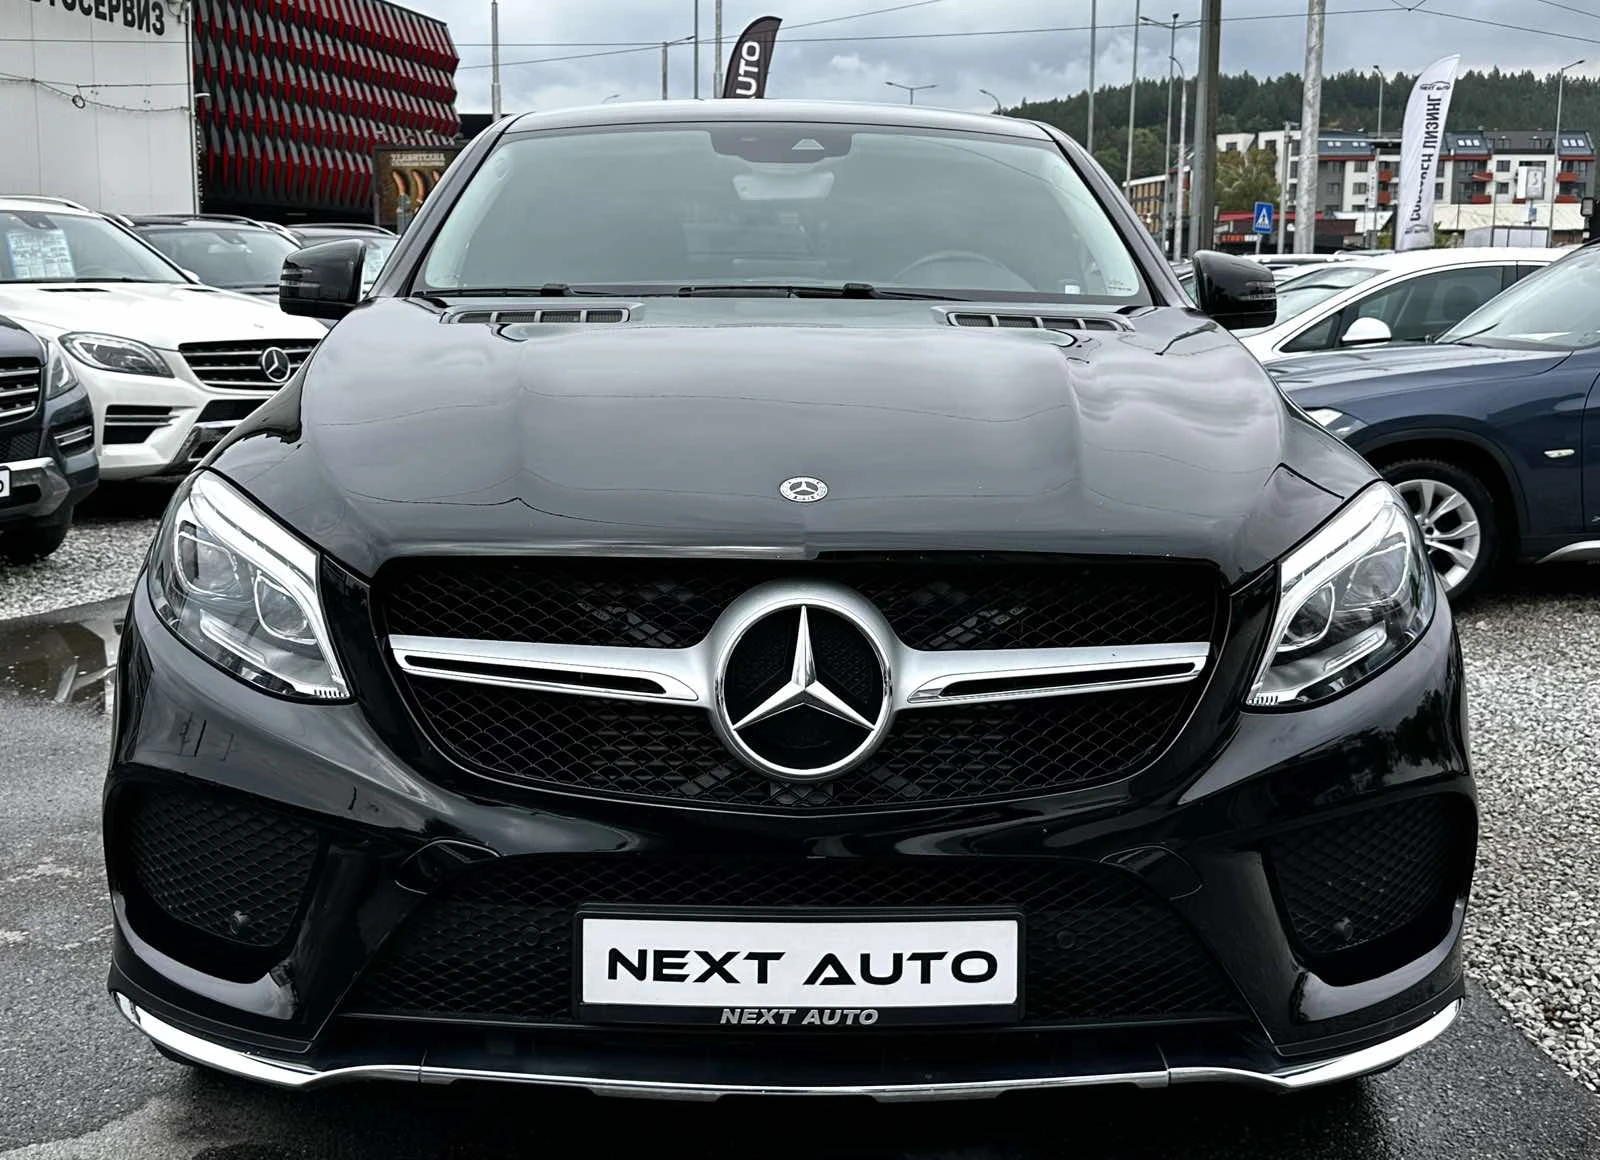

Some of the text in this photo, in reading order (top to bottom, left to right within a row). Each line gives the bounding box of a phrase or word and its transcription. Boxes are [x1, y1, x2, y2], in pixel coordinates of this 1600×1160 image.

[736, 41, 760, 98] UTO
[1423, 94, 1442, 149] ЛИЗИНГ
[607, 947, 998, 986] NEXT AUTO
[720, 1008, 879, 1026] NEXT AUTO
